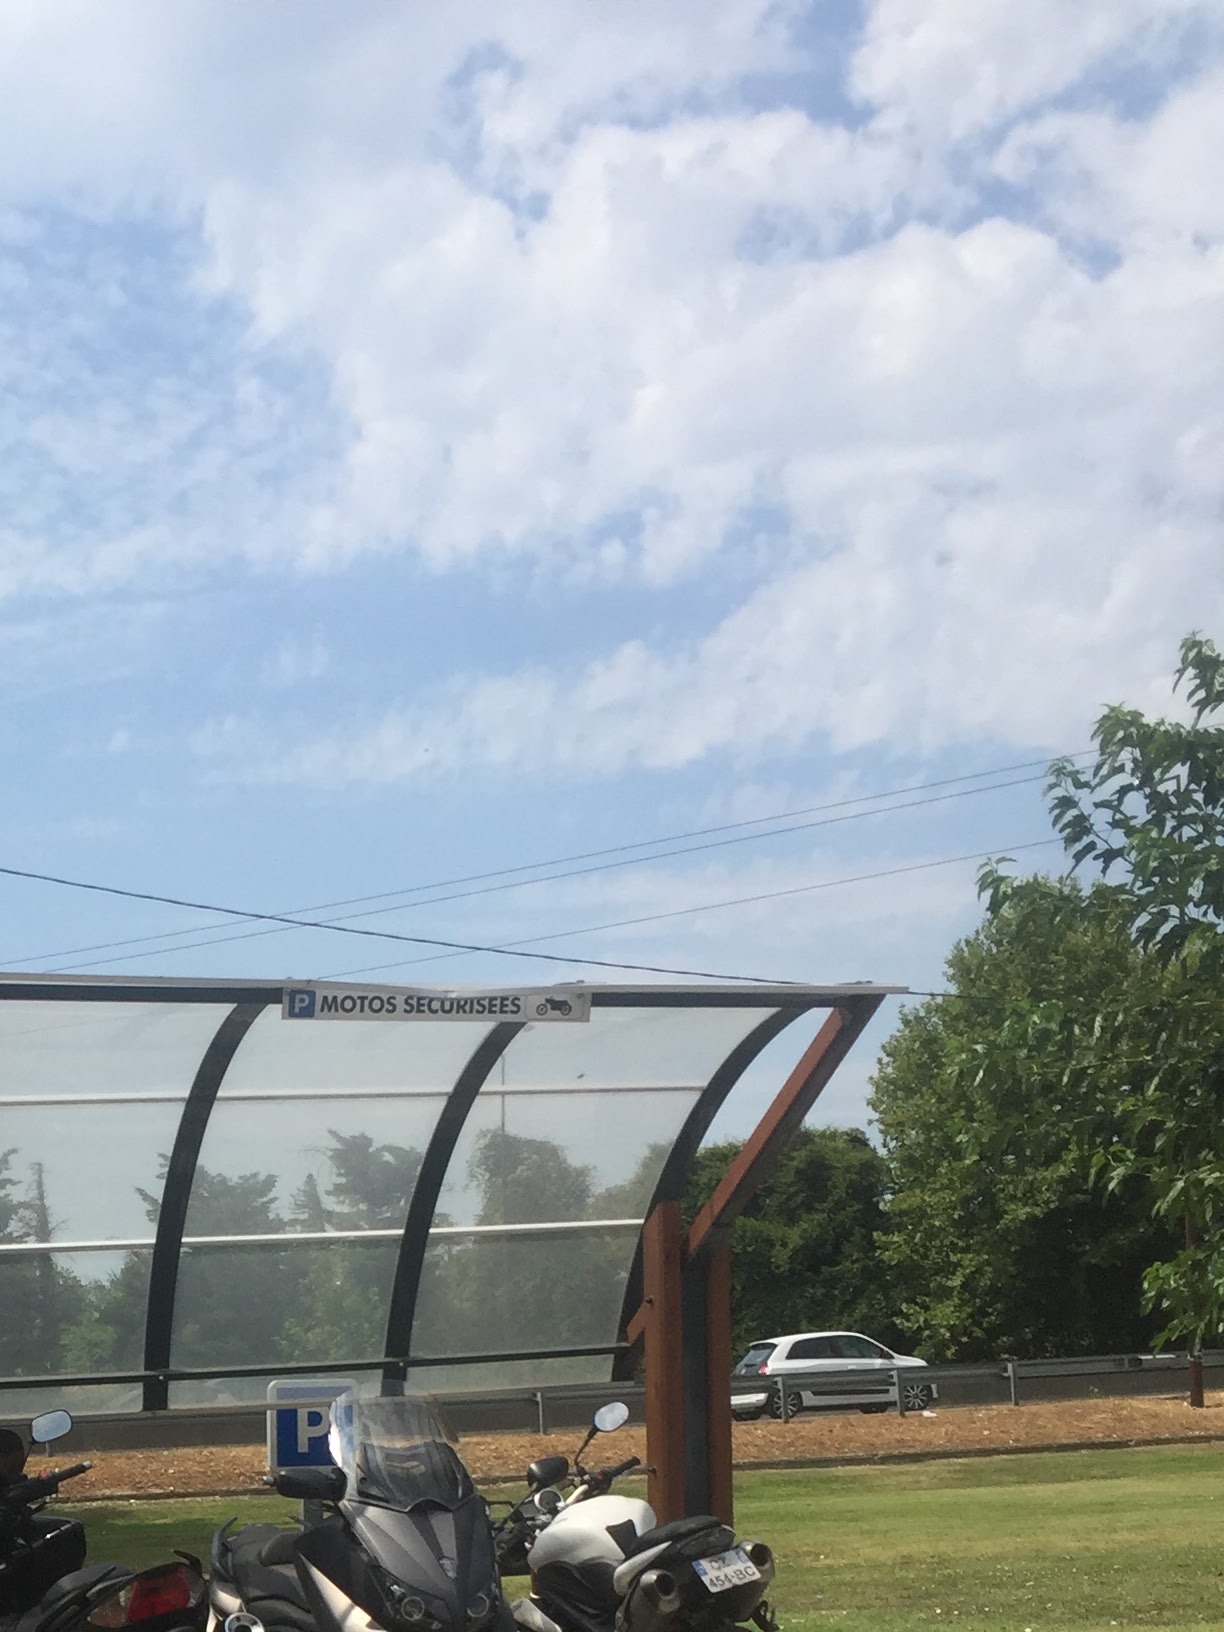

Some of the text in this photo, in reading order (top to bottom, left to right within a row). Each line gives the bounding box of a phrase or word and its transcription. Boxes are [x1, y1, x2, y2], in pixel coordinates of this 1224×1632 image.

[294, 993, 310, 1015] P
[320, 995, 397, 1014] MOTOS
[297, 1406, 330, 1453] P
